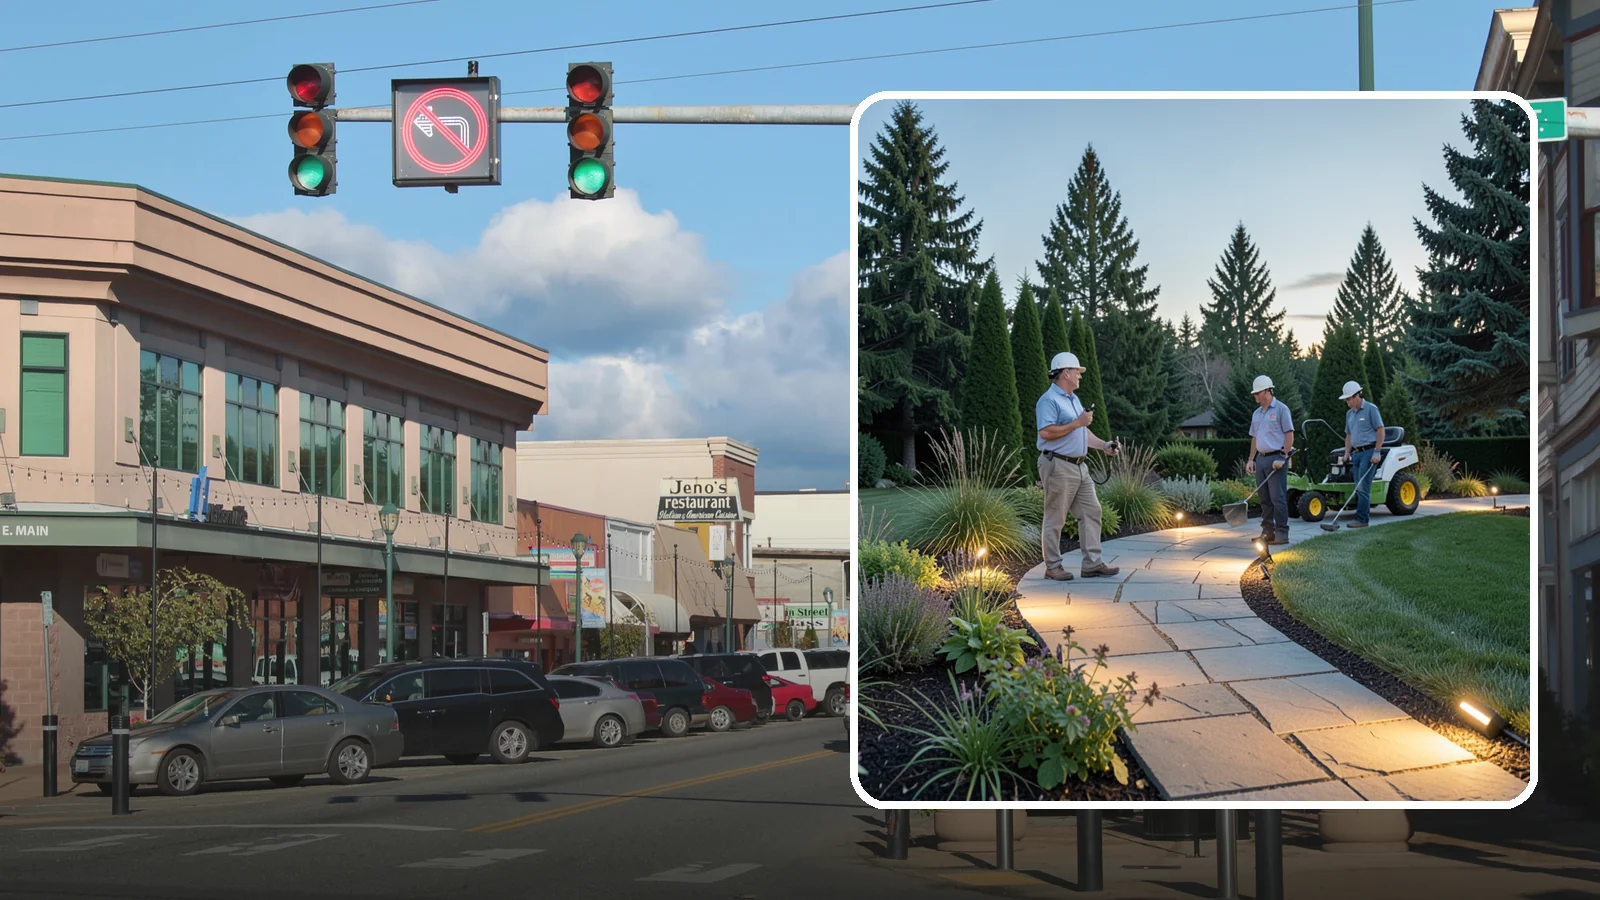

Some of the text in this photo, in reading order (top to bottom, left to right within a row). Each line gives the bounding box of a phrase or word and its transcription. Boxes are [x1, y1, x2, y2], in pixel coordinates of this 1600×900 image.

[670, 480, 727, 494] Jeno's
[665, 496, 731, 509] restaurant
[658, 509, 681, 519] Italian
[686, 509, 714, 519] American
[714, 509, 738, 519] Cuisine
[2, 525, 49, 536] E. MAIN
[797, 607, 829, 617] Street
[791, 619, 824, 627] lass
